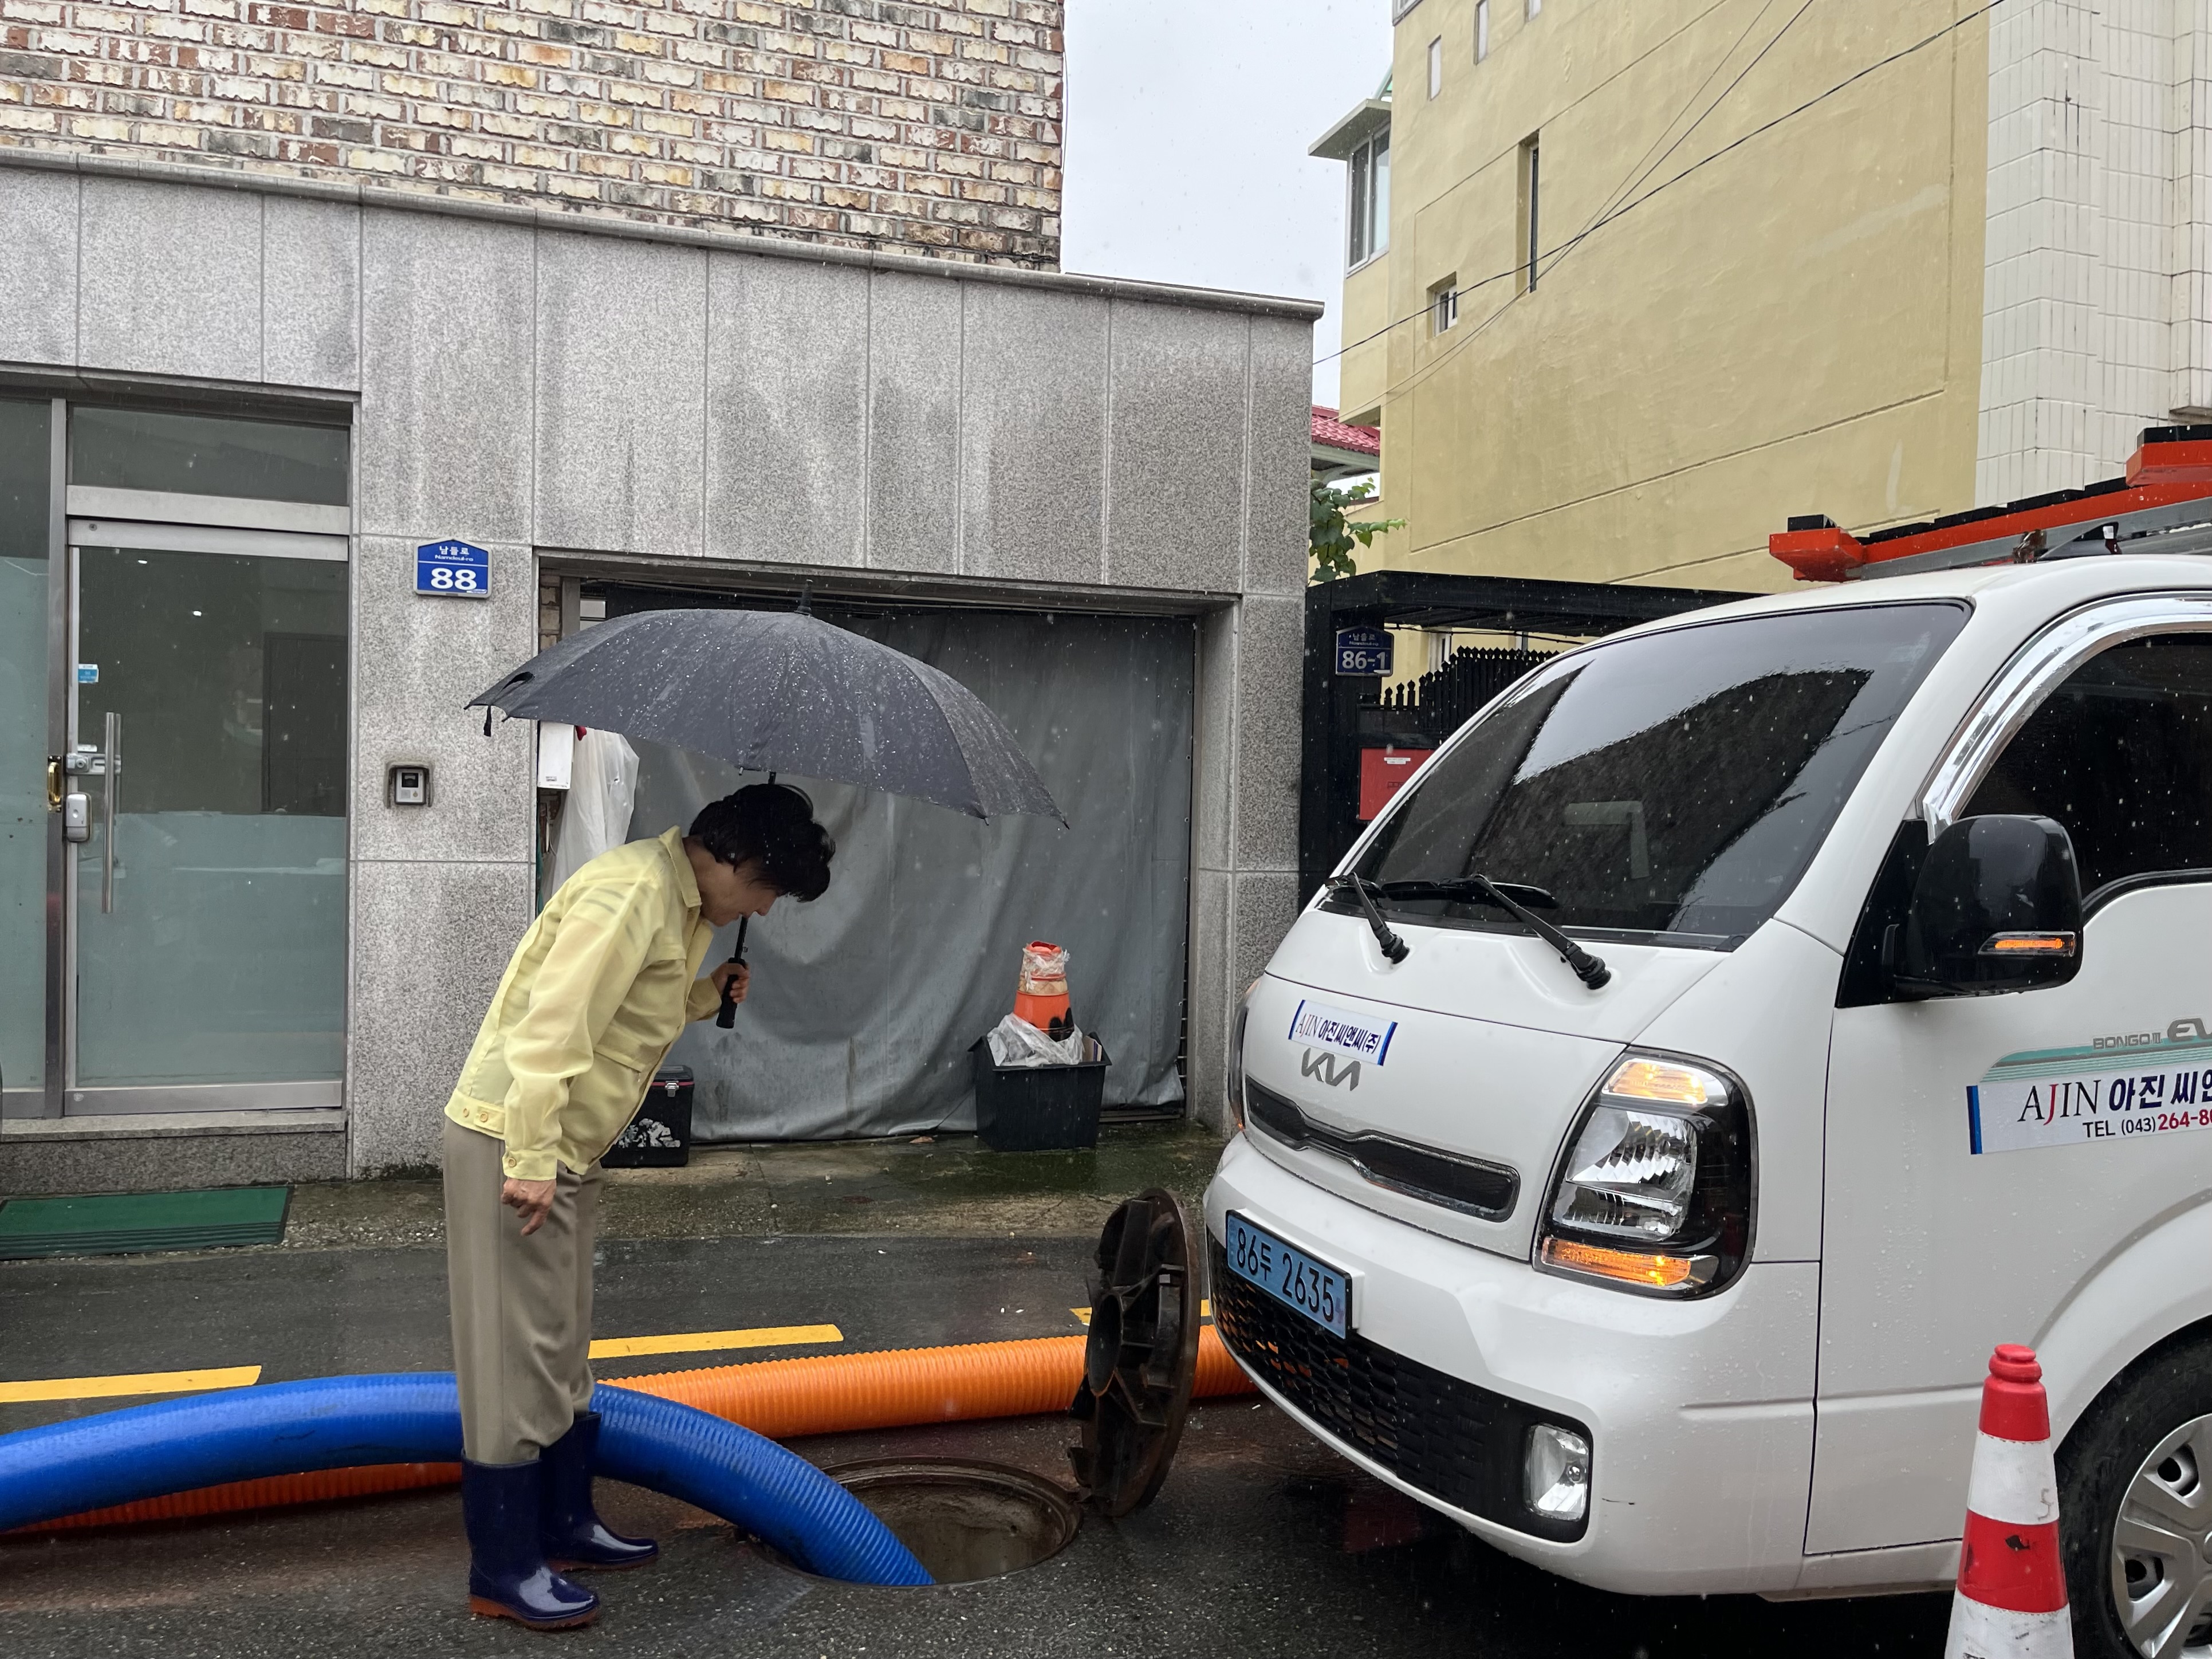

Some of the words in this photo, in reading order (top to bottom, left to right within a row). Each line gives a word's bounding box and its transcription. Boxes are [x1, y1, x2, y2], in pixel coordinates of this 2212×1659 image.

[431, 568, 477, 591] 88
[1342, 650, 1386, 670] 86-1
[1295, 1013, 1323, 1038] AJIN
[2092, 1033, 2150, 1050] BONGO
[2017, 1080, 2101, 1126] AJIN
[2083, 1120, 2116, 1138] TEL
[2121, 1108, 2212, 1136] (043)264-8
[1237, 1227, 1272, 1282] 86두
[1282, 1252, 1334, 1323] 2635
